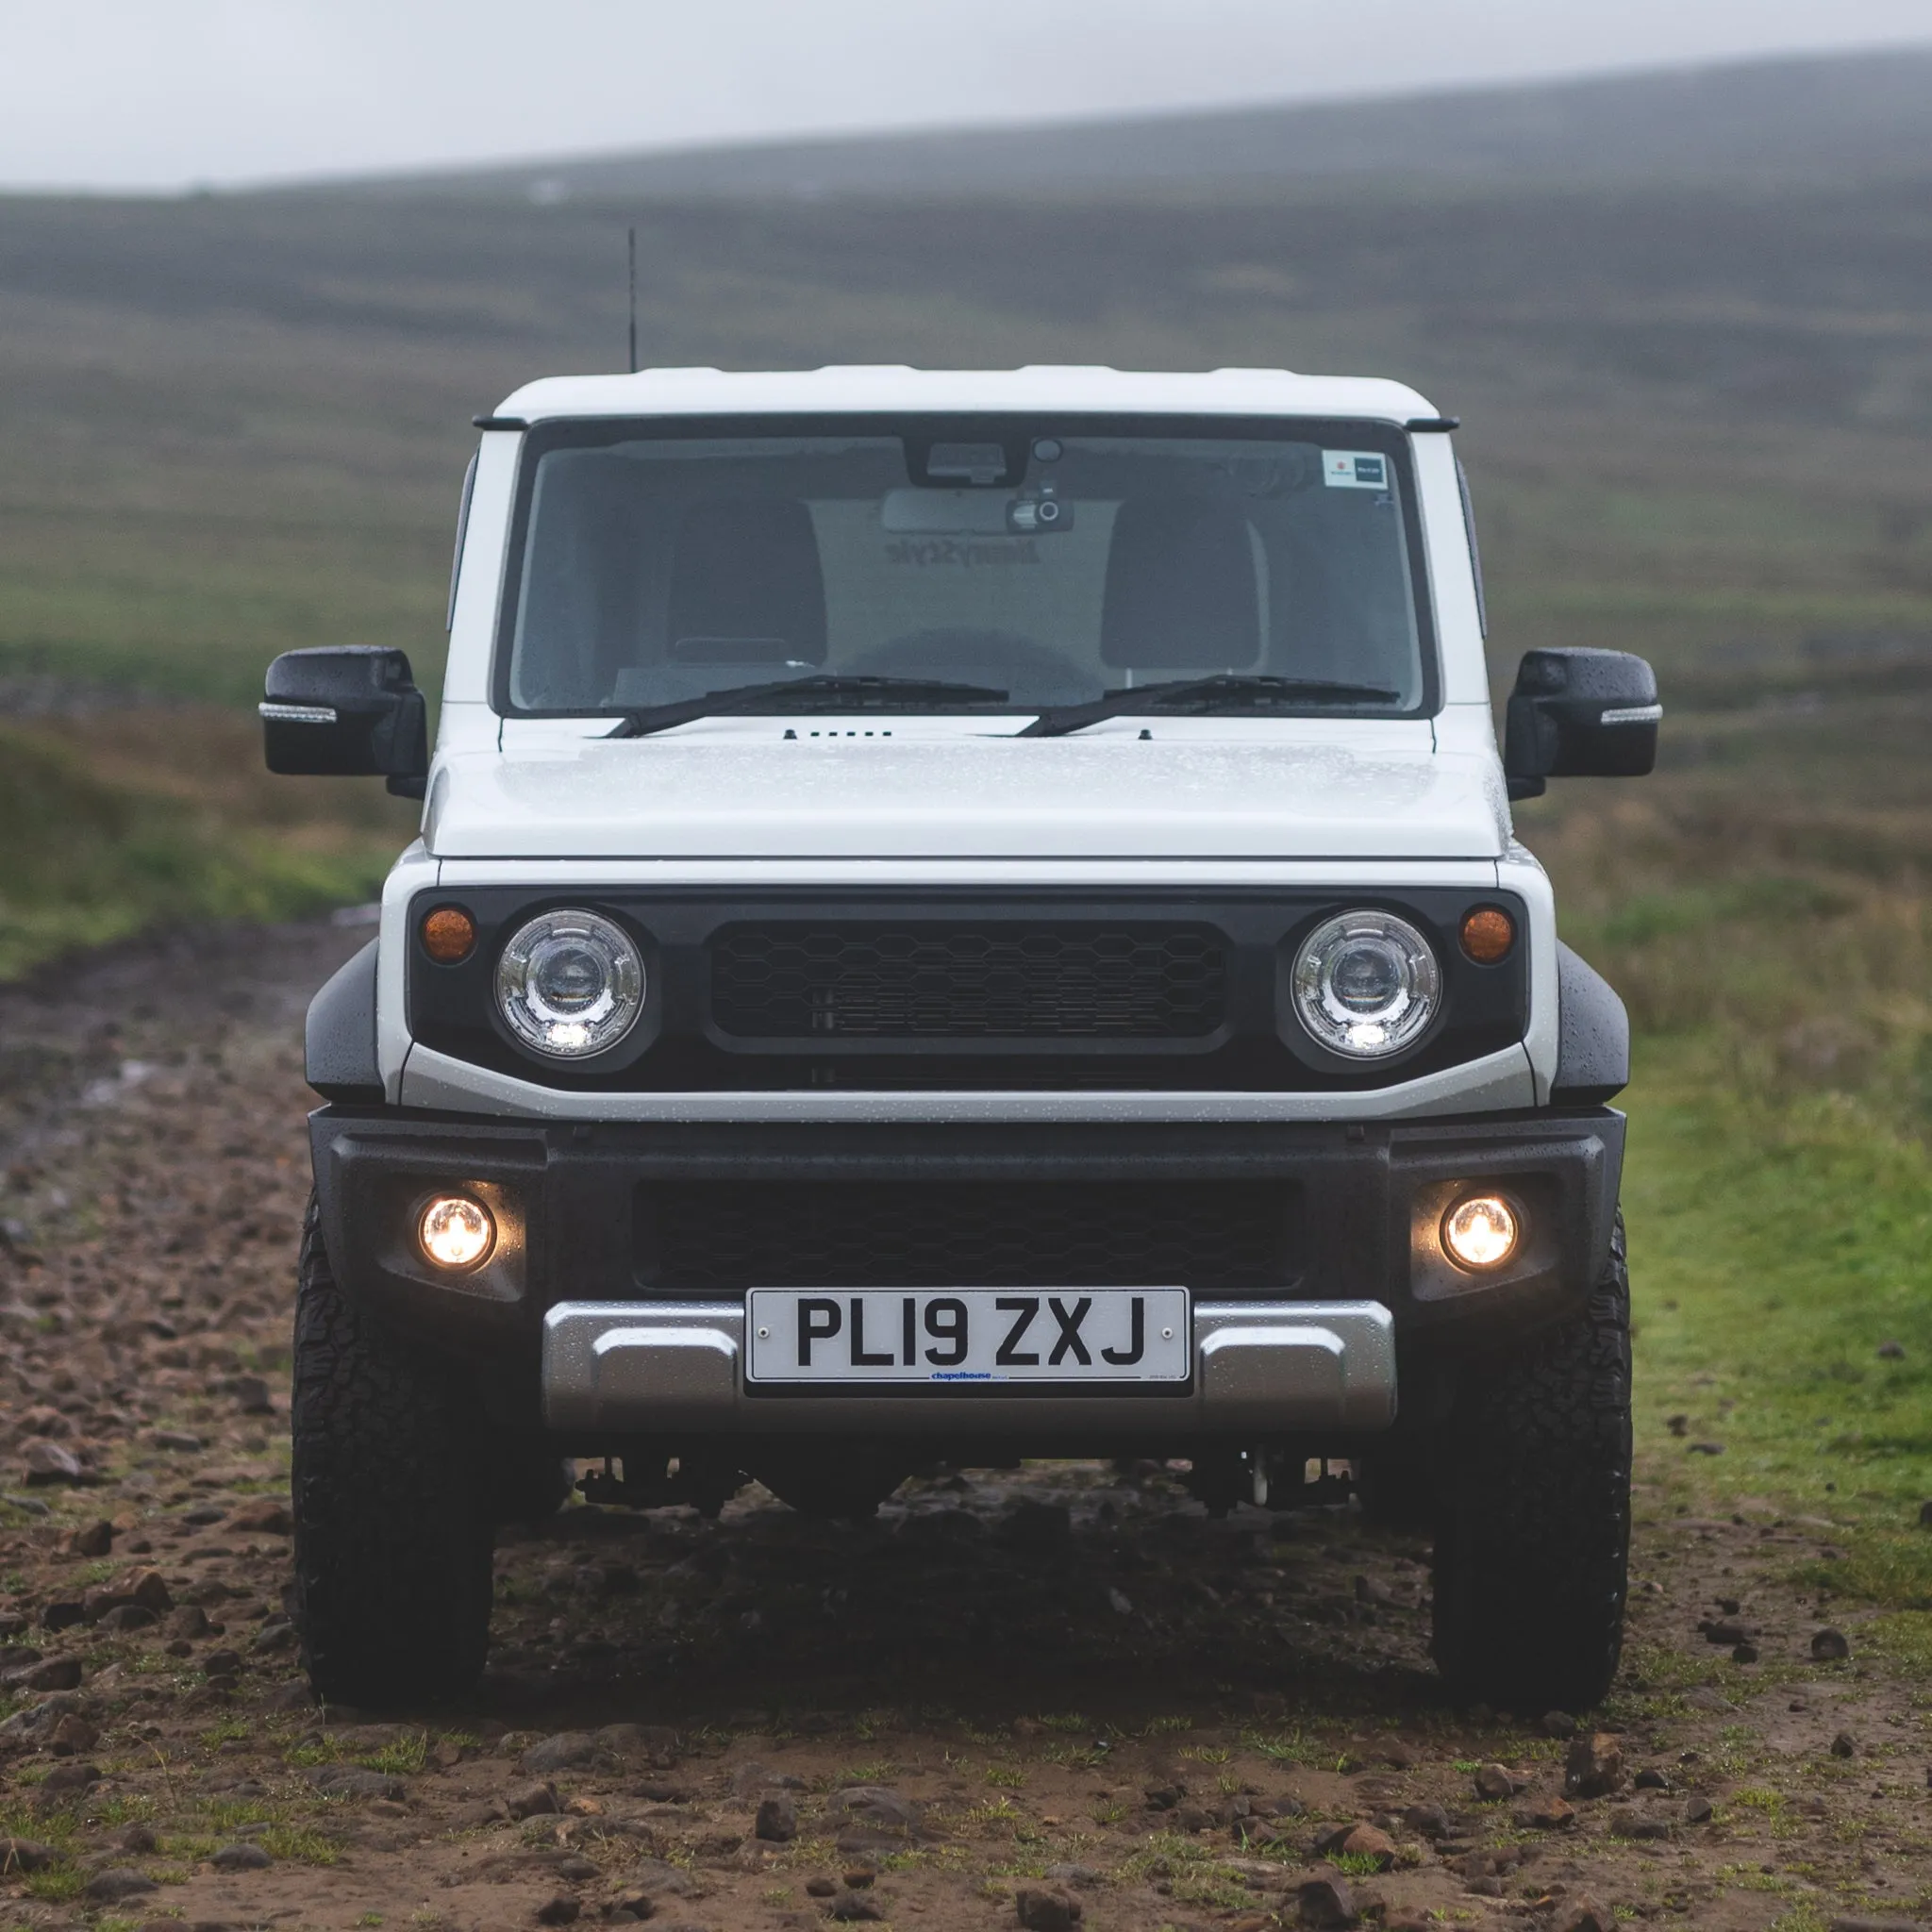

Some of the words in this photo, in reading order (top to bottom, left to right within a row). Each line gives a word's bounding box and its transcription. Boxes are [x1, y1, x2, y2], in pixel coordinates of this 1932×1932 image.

[797, 1298, 968, 1367] PL19
[995, 1298, 1144, 1367] ZXJ
[931, 1372, 991, 1381] chapelhouse
